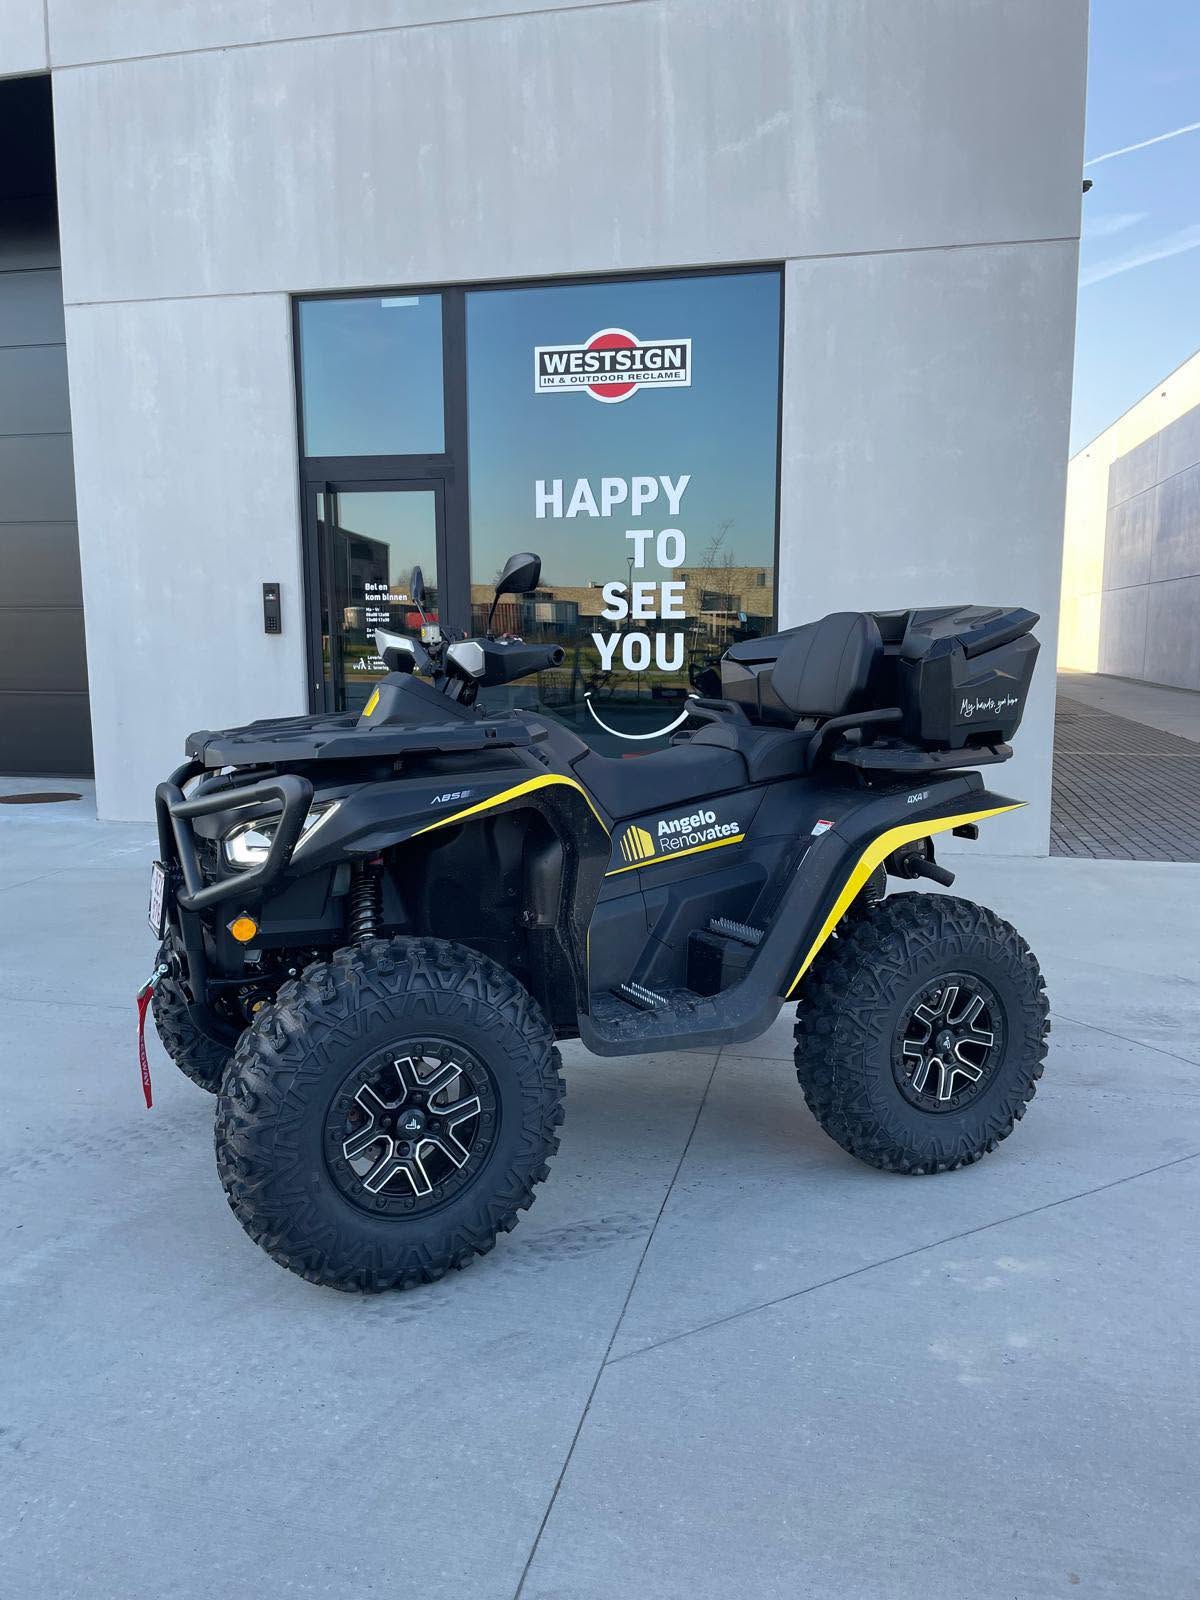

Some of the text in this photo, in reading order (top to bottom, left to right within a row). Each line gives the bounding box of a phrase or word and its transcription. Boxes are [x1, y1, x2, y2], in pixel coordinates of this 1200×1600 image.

[543, 348, 682, 374] WESTSIGN
[558, 376, 566, 384] &
[570, 374, 624, 383] OUTDOOR
[628, 371, 681, 380] RECLAME
[535, 475, 691, 518] HAPPY
[625, 528, 686, 568] TO
[365, 583, 377, 591] Bel
[365, 593, 408, 601] kom binnen
[601, 581, 686, 620] SEE
[591, 632, 684, 671] YOU
[657, 809, 716, 837] Angelo
[659, 821, 740, 852] Renovates
